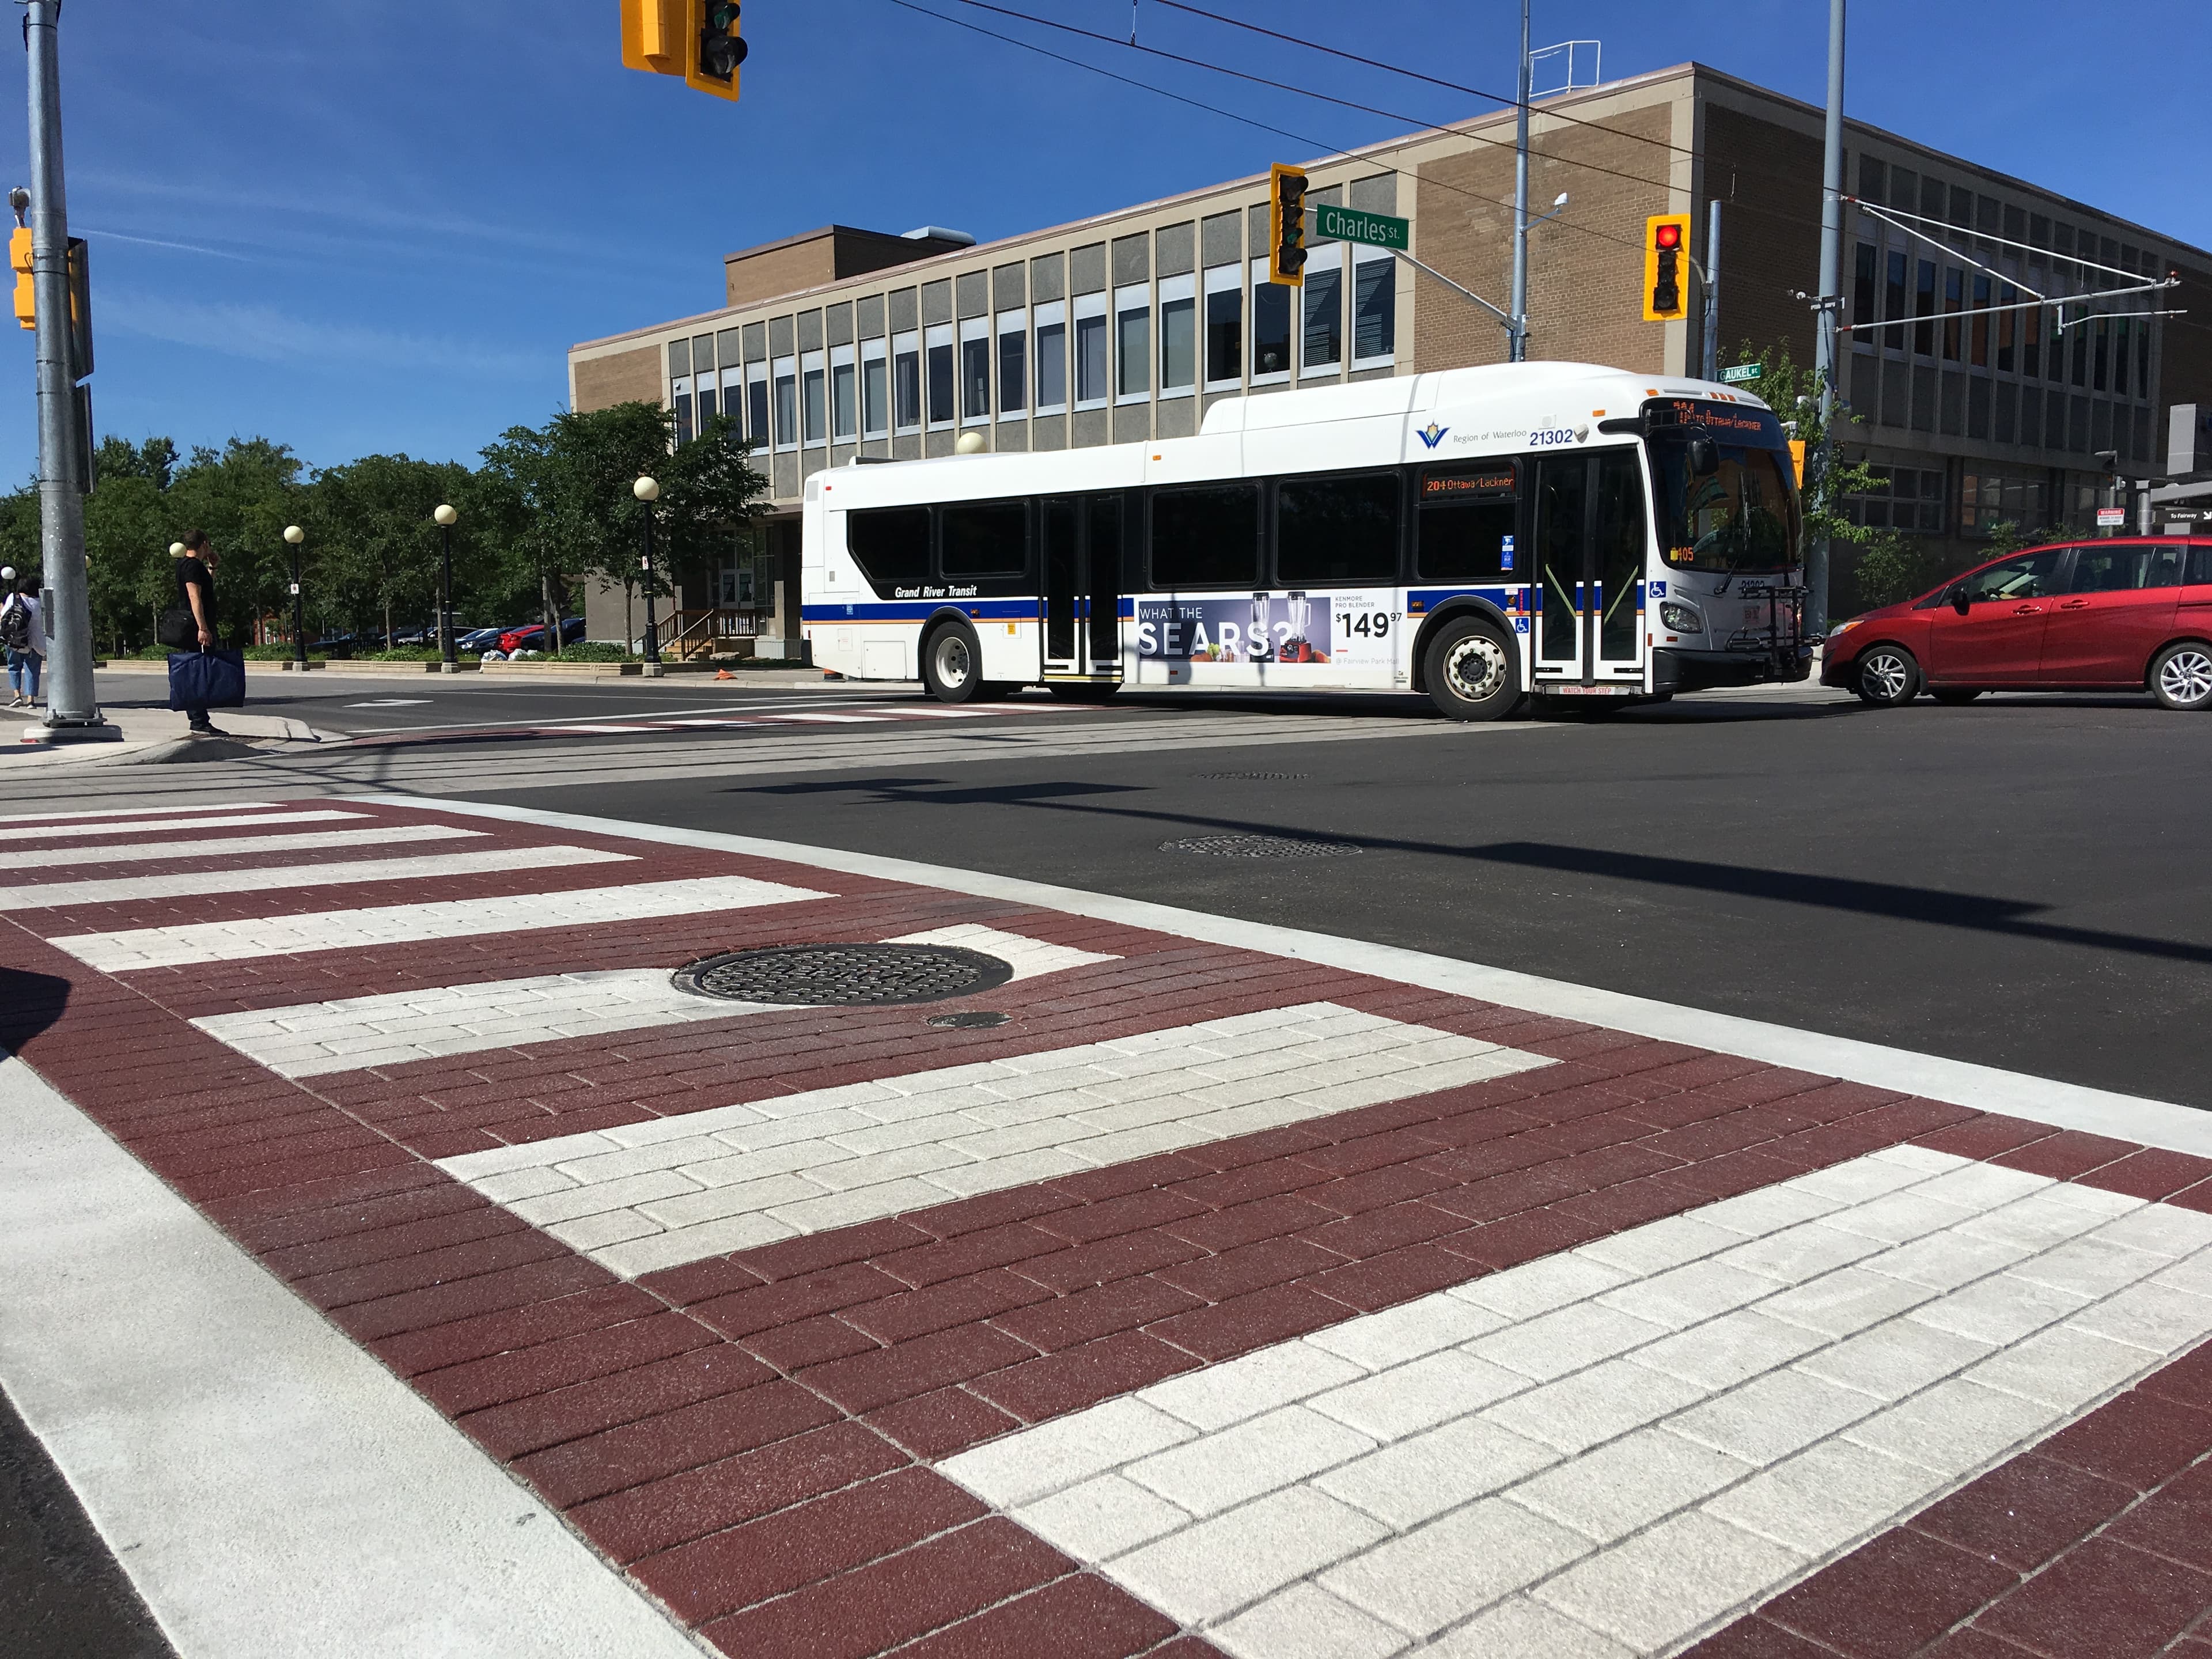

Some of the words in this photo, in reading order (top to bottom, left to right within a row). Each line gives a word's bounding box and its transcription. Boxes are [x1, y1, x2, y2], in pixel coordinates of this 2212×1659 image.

[1326, 211, 1386, 242] Charles
[1719, 367, 1752, 380] GAUKEL
[1453, 435, 1478, 444] Region
[1481, 432, 1489, 440] of
[1493, 430, 1527, 440] Waterloo
[1529, 429, 1574, 446] 21302
[1426, 480, 1447, 491] 204
[1447, 476, 1514, 490] Ottawa/Lackner
[895, 586, 920, 598] Grand
[923, 586, 945, 597] River
[948, 584, 978, 597] Transit
[1140, 608, 1174, 620] WHAT
[1179, 607, 1203, 619] THE
[1138, 621, 1293, 657] SEARS?
